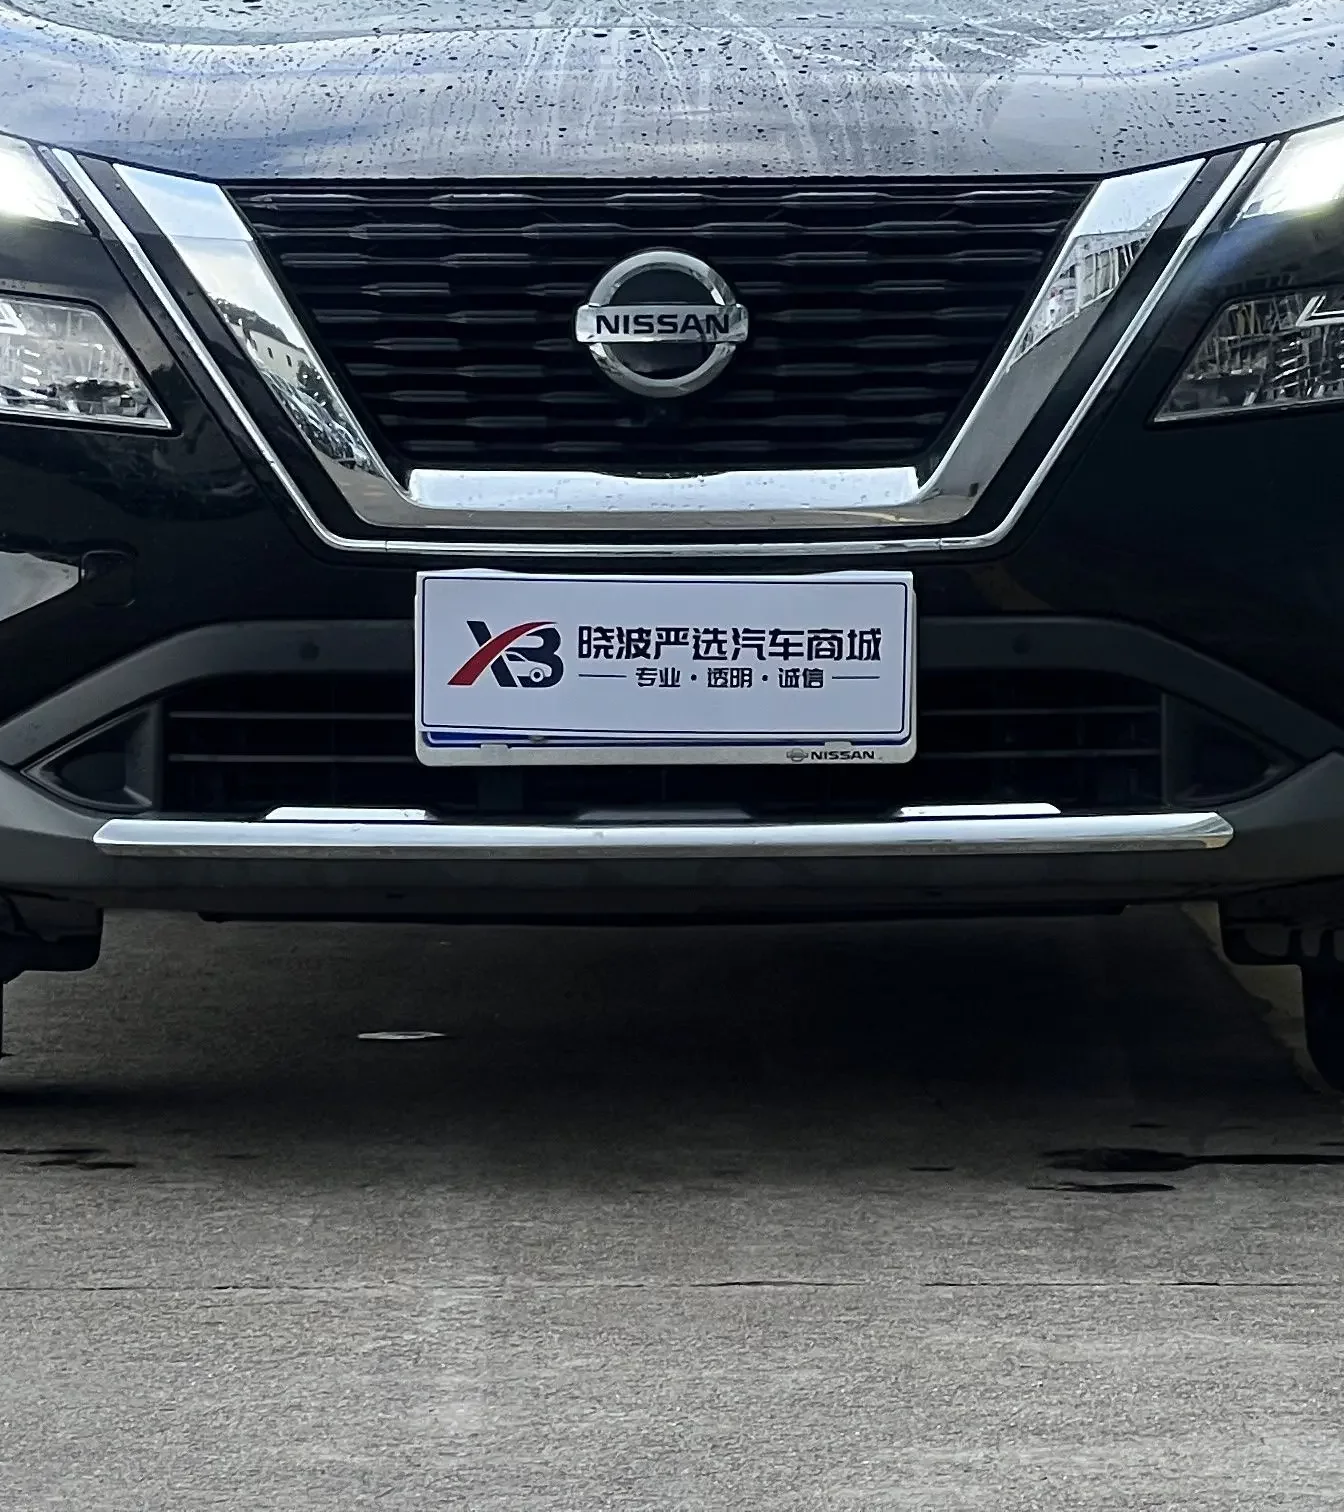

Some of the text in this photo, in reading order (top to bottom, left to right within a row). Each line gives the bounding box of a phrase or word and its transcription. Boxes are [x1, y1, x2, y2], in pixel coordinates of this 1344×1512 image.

[596, 314, 730, 334] NISSAN
[578, 626, 882, 661] 晓波严选汽车商城
[810, 751, 875, 760] NISSAN
